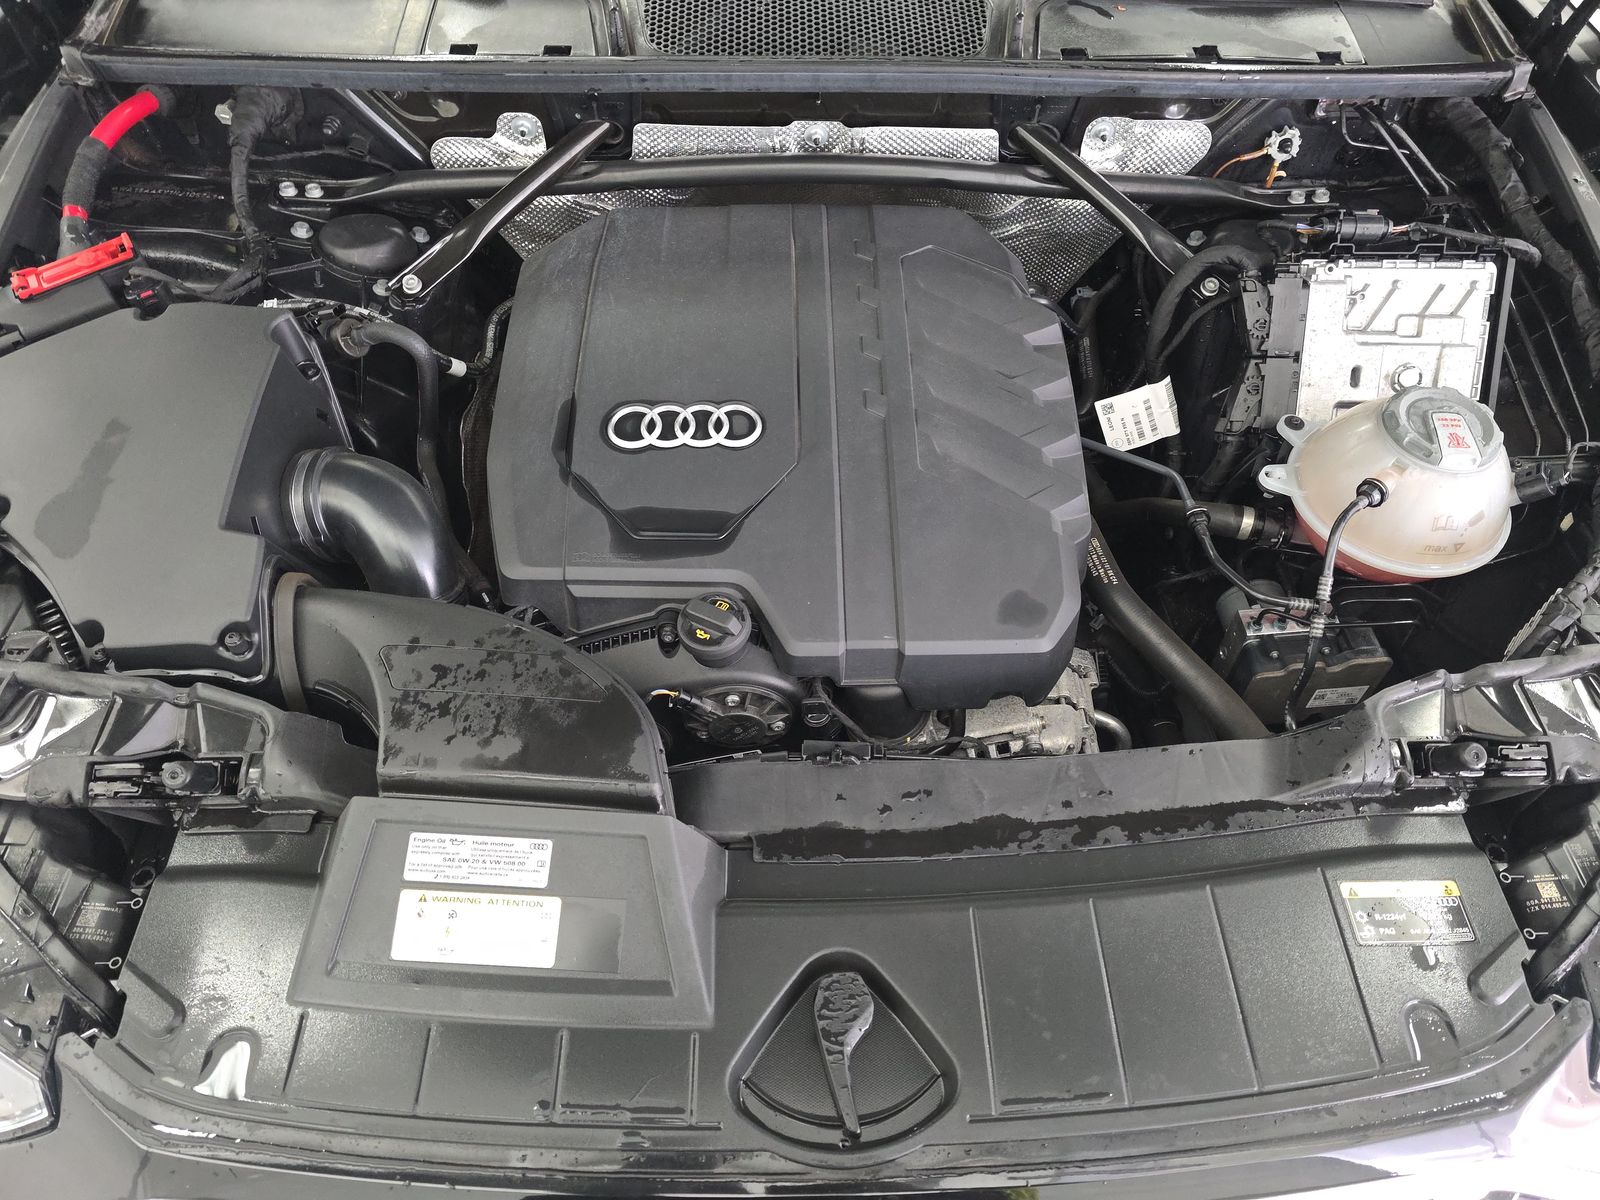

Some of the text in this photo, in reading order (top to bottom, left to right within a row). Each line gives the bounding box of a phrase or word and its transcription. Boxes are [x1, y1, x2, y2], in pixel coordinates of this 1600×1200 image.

[1423, 544, 1448, 553] max
[413, 836, 435, 844] Engine
[431, 895, 544, 908] WARNING ATTENTION
[1378, 927, 1396, 935] PAG
